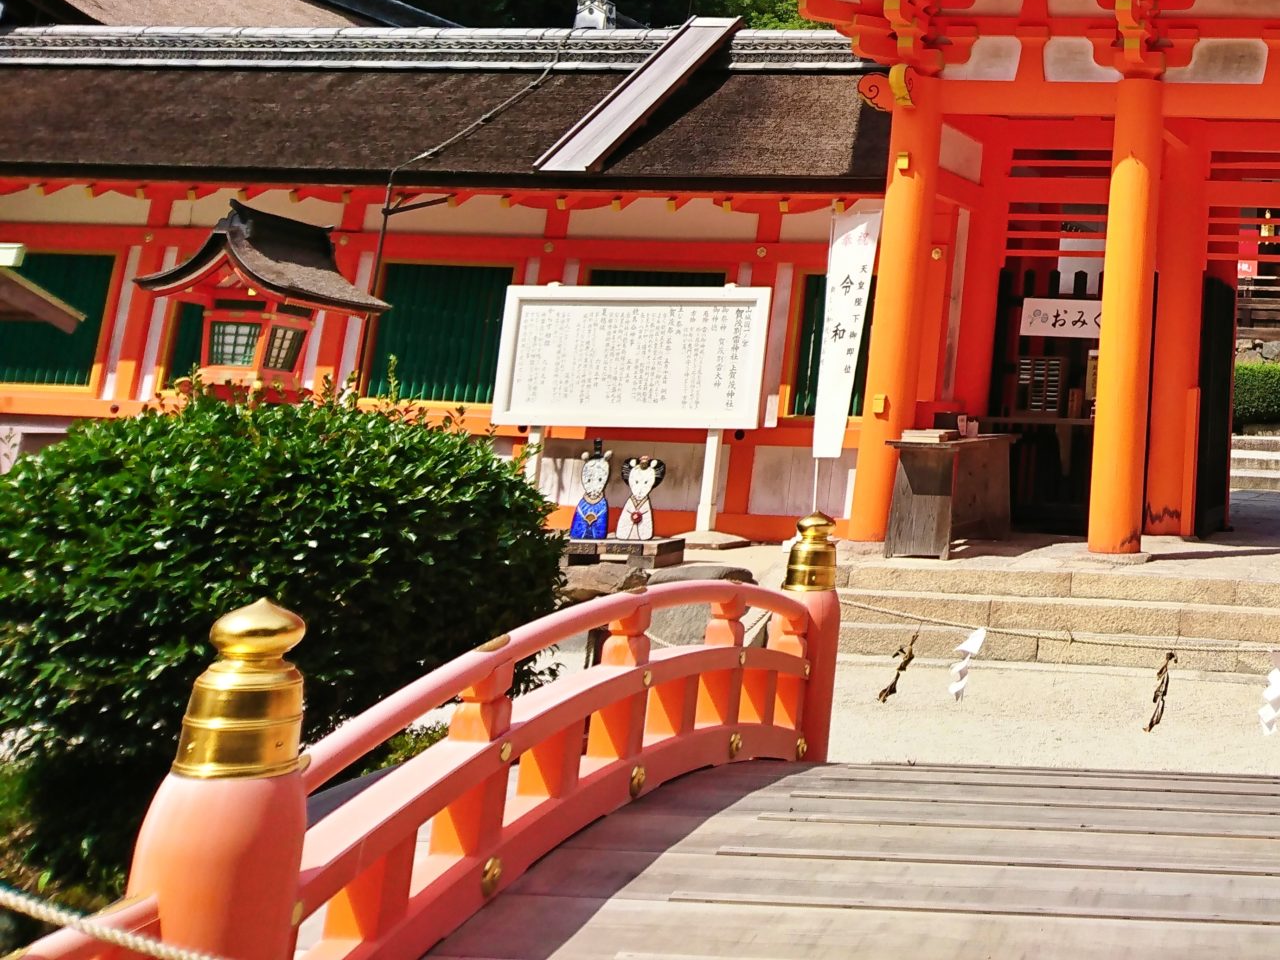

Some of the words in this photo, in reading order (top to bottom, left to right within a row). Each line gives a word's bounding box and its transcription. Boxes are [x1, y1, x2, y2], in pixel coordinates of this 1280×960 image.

[831, 274, 854, 343] 令和
[844, 264, 868, 374] 天皇陛下御即位
